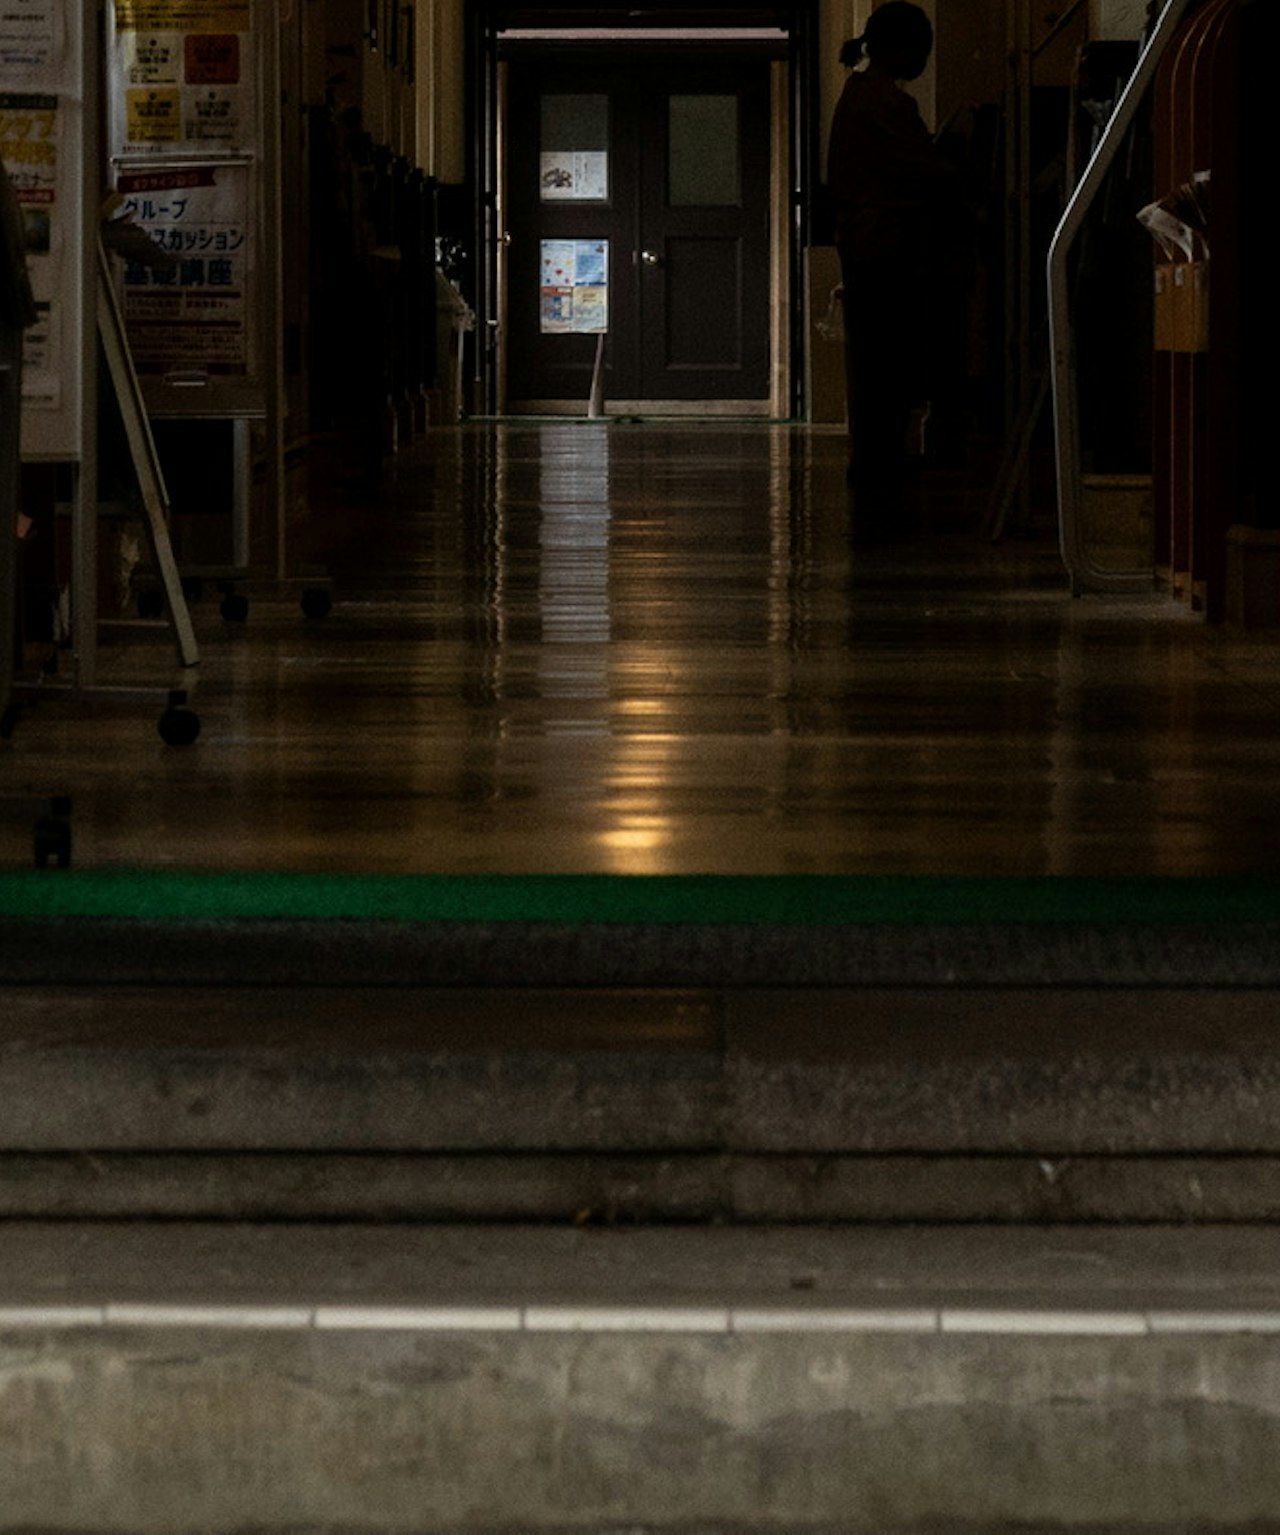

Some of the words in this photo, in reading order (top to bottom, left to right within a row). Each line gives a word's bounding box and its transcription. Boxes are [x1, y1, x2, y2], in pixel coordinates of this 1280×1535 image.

[126, 198, 189, 220] グループ
[148, 229, 244, 251] スカッション
